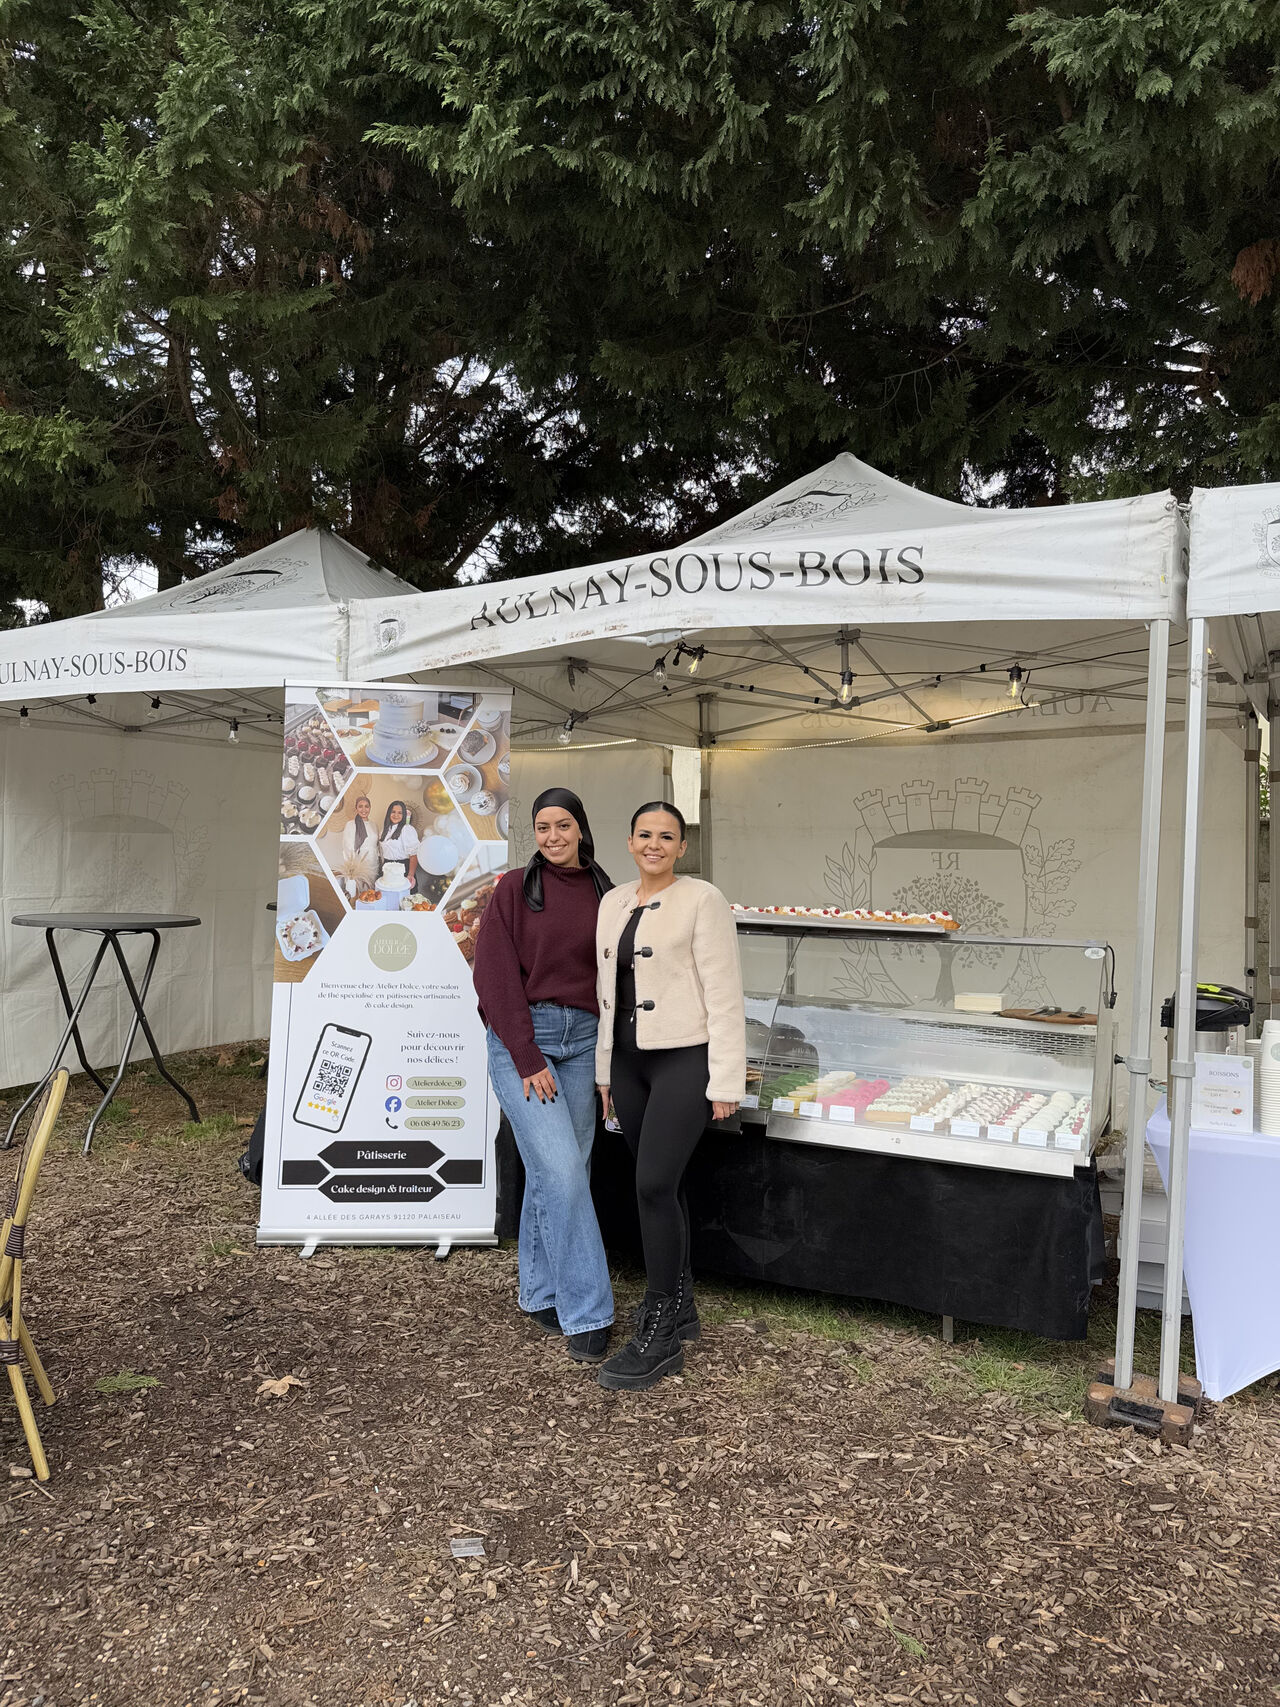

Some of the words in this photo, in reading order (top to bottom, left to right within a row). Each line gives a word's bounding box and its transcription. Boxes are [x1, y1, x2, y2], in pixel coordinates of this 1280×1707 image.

[470, 545, 925, 631] AULNAY-SOUS-BOIS
[320, 982, 358, 990] Bienvenue
[358, 982, 374, 990] chez
[377, 982, 398, 990] Atelier
[440, 983, 459, 991] salon
[407, 1030, 460, 1038] Suivez-nous
[331, 1041, 354, 1052] Scannez
[400, 1044, 421, 1052] pour
[330, 1050, 340, 1059] QR
[340, 1053, 355, 1062] Code
[424, 1055, 454, 1064] délices
[1208, 1070, 1240, 1078] BOISSONS
[313, 1093, 337, 1105] Google
[356, 1150, 407, 1160] Pâtisserie
[330, 1184, 356, 1194] Cake
[356, 1184, 386, 1195] design
[387, 1184, 397, 1193] &
[398, 1184, 434, 1193] traiteur
